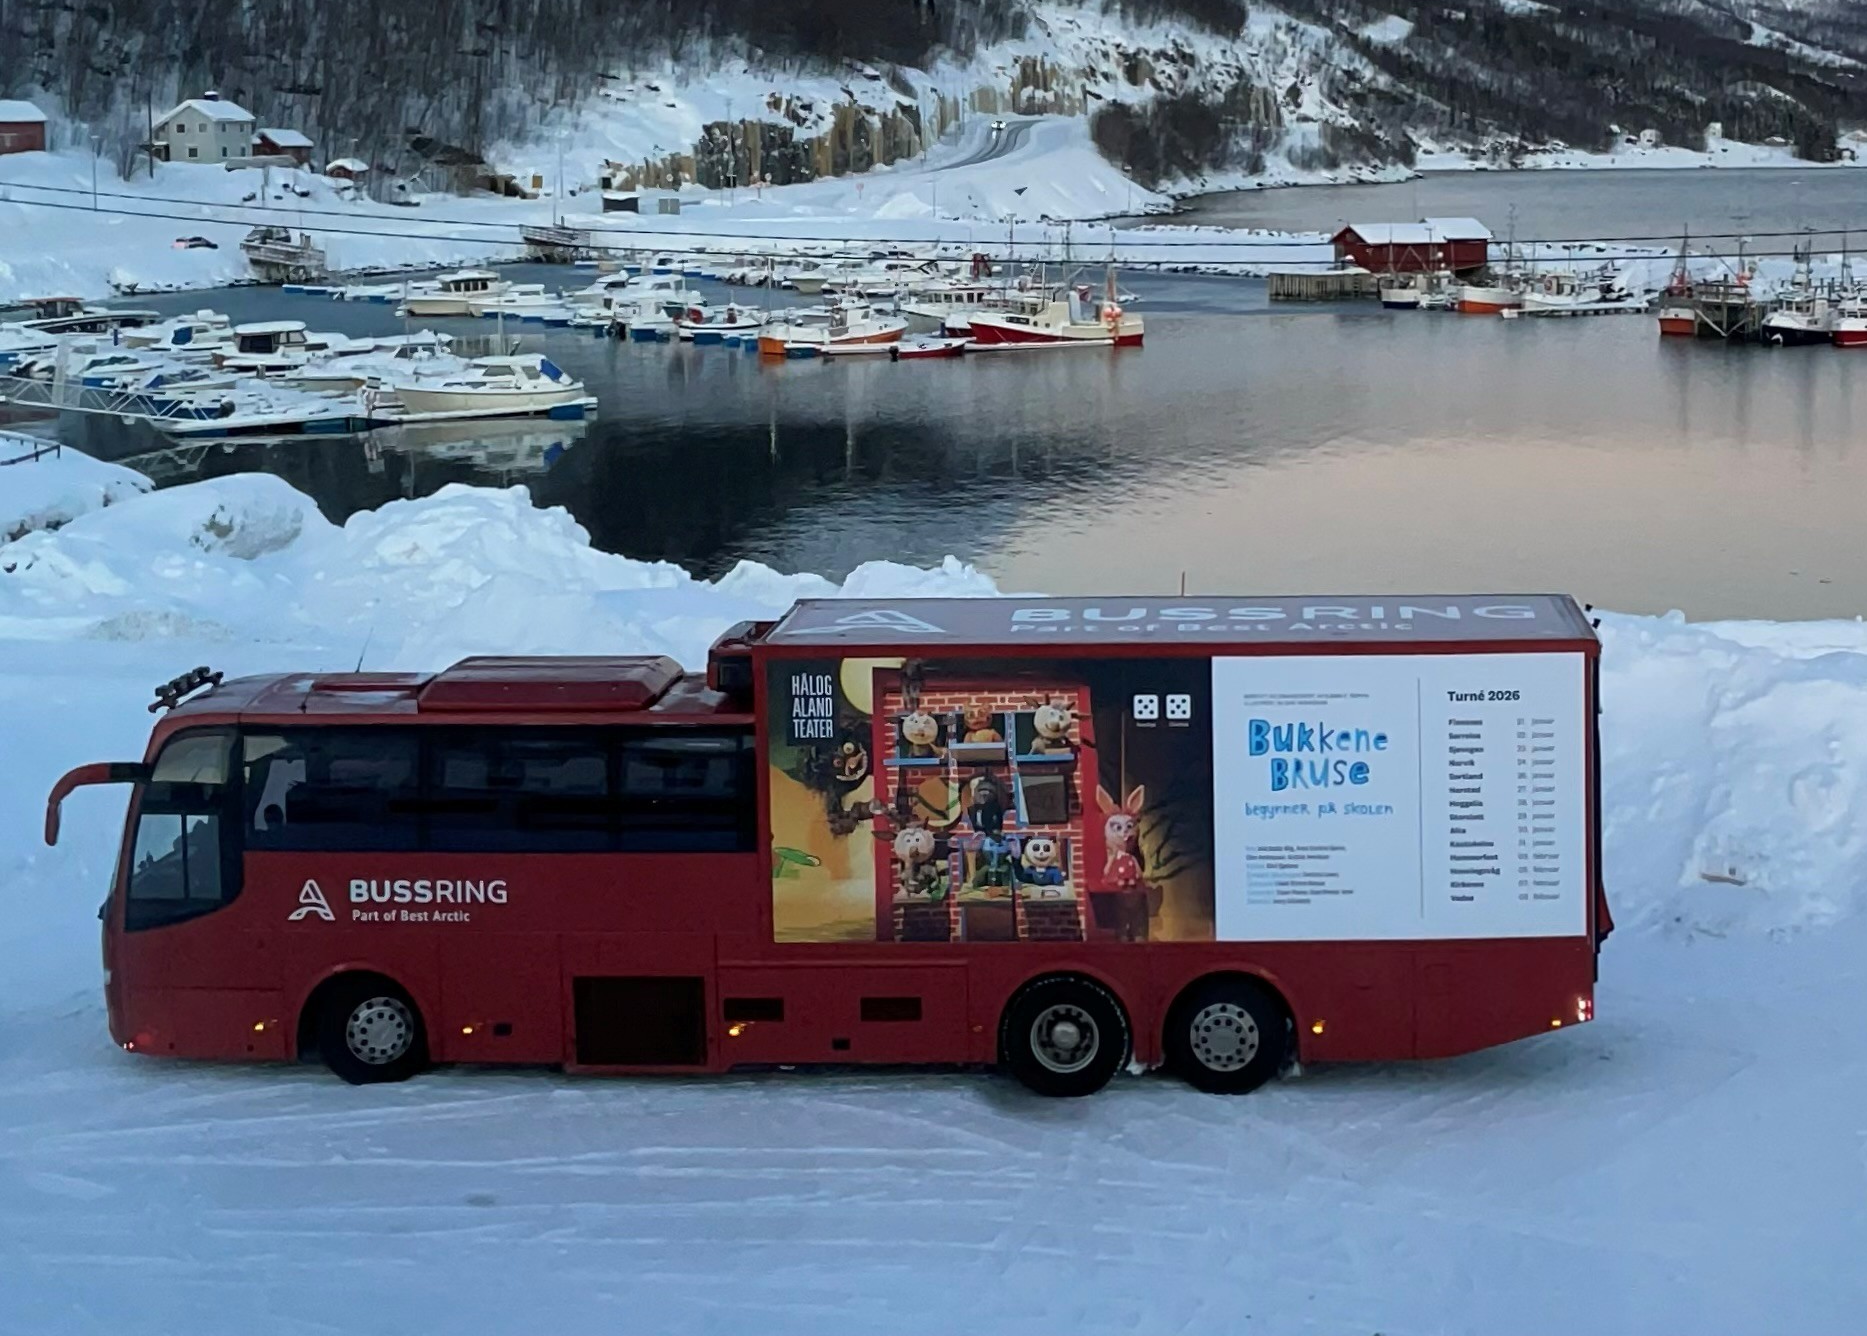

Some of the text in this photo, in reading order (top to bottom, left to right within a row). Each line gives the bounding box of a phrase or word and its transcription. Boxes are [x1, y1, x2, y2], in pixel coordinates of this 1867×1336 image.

[1011, 606, 1535, 622] BUSSRING
[1177, 623, 1271, 631] Best
[1289, 622, 1413, 630] Arctic
[791, 672, 833, 696] HÅLOG
[1447, 690, 1520, 702] Turné 2026
[792, 697, 833, 718] ALAND
[793, 719, 834, 739] TEATER
[350, 879, 508, 903] BUSSRING
[352, 910, 471, 922] Part of Best Arctic
